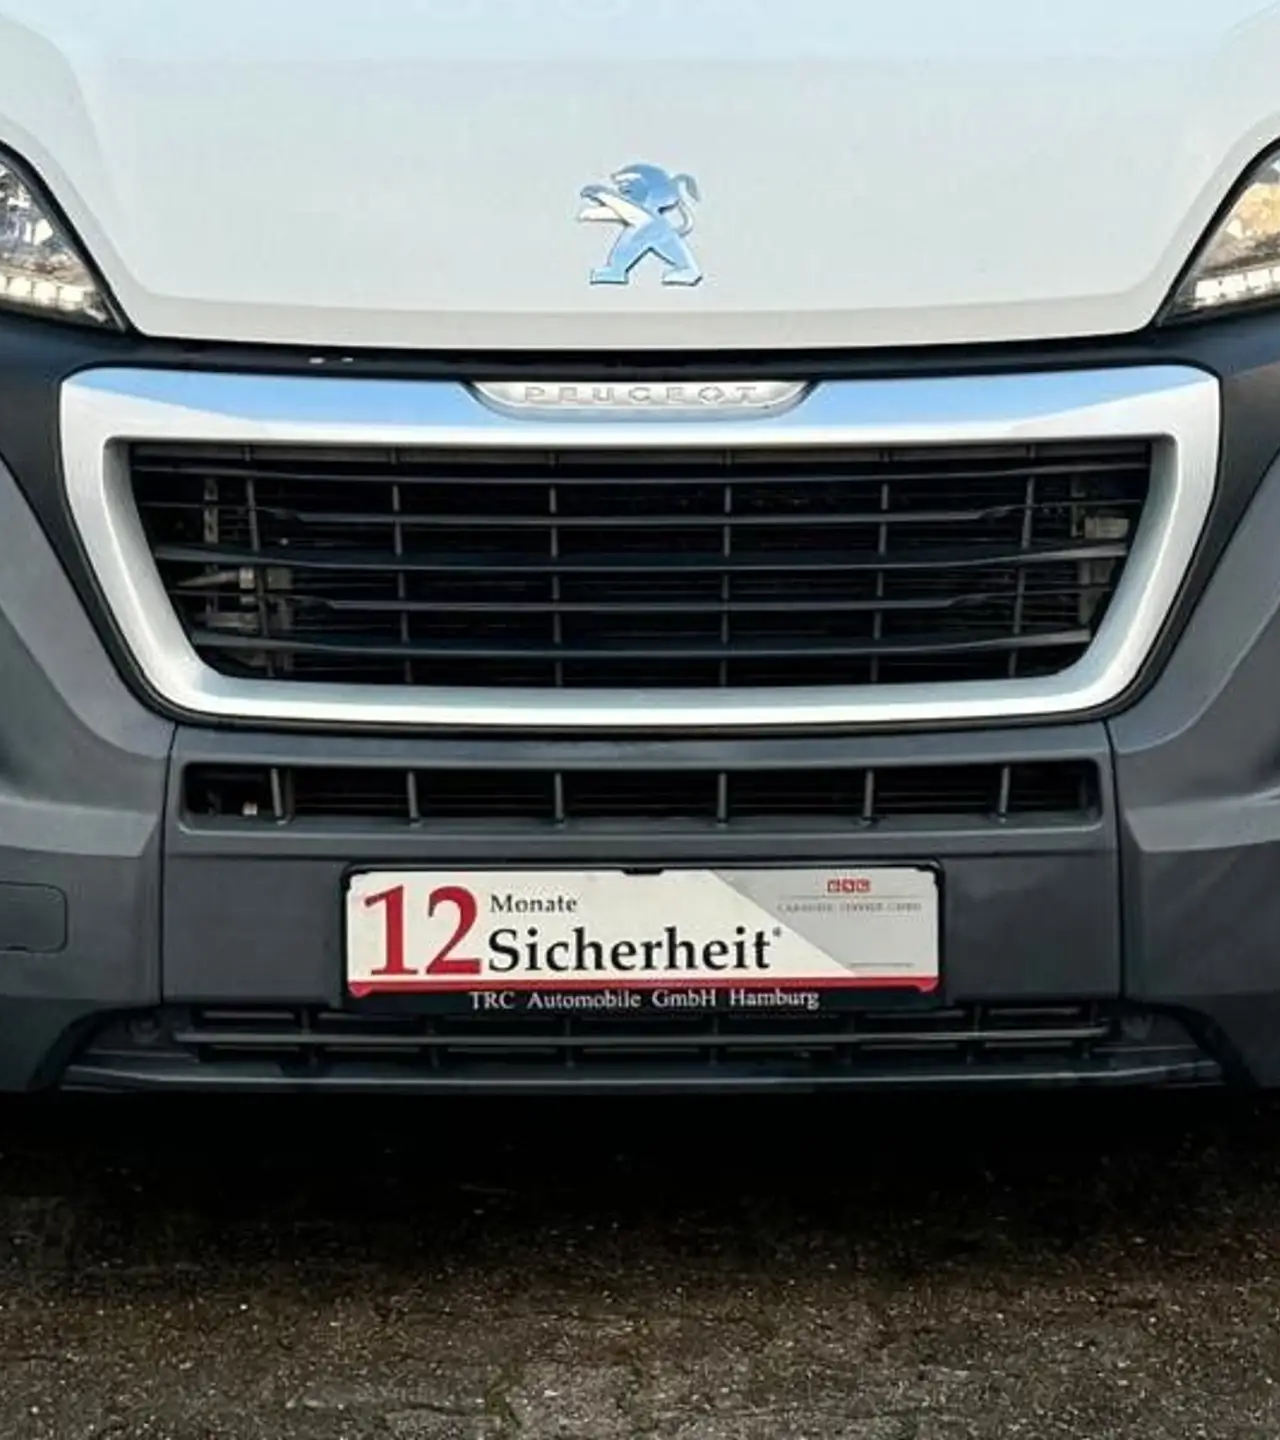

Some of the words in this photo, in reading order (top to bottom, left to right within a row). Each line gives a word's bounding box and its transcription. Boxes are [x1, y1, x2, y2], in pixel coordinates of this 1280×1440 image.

[523, 385, 758, 403] PEUGEOT
[364, 884, 483, 976] 12
[489, 892, 578, 913] Monate
[468, 990, 517, 1010] TRC
[526, 989, 642, 1009] Automobile
[651, 988, 718, 1008] GmbH
[728, 987, 820, 1011] Hamburg
